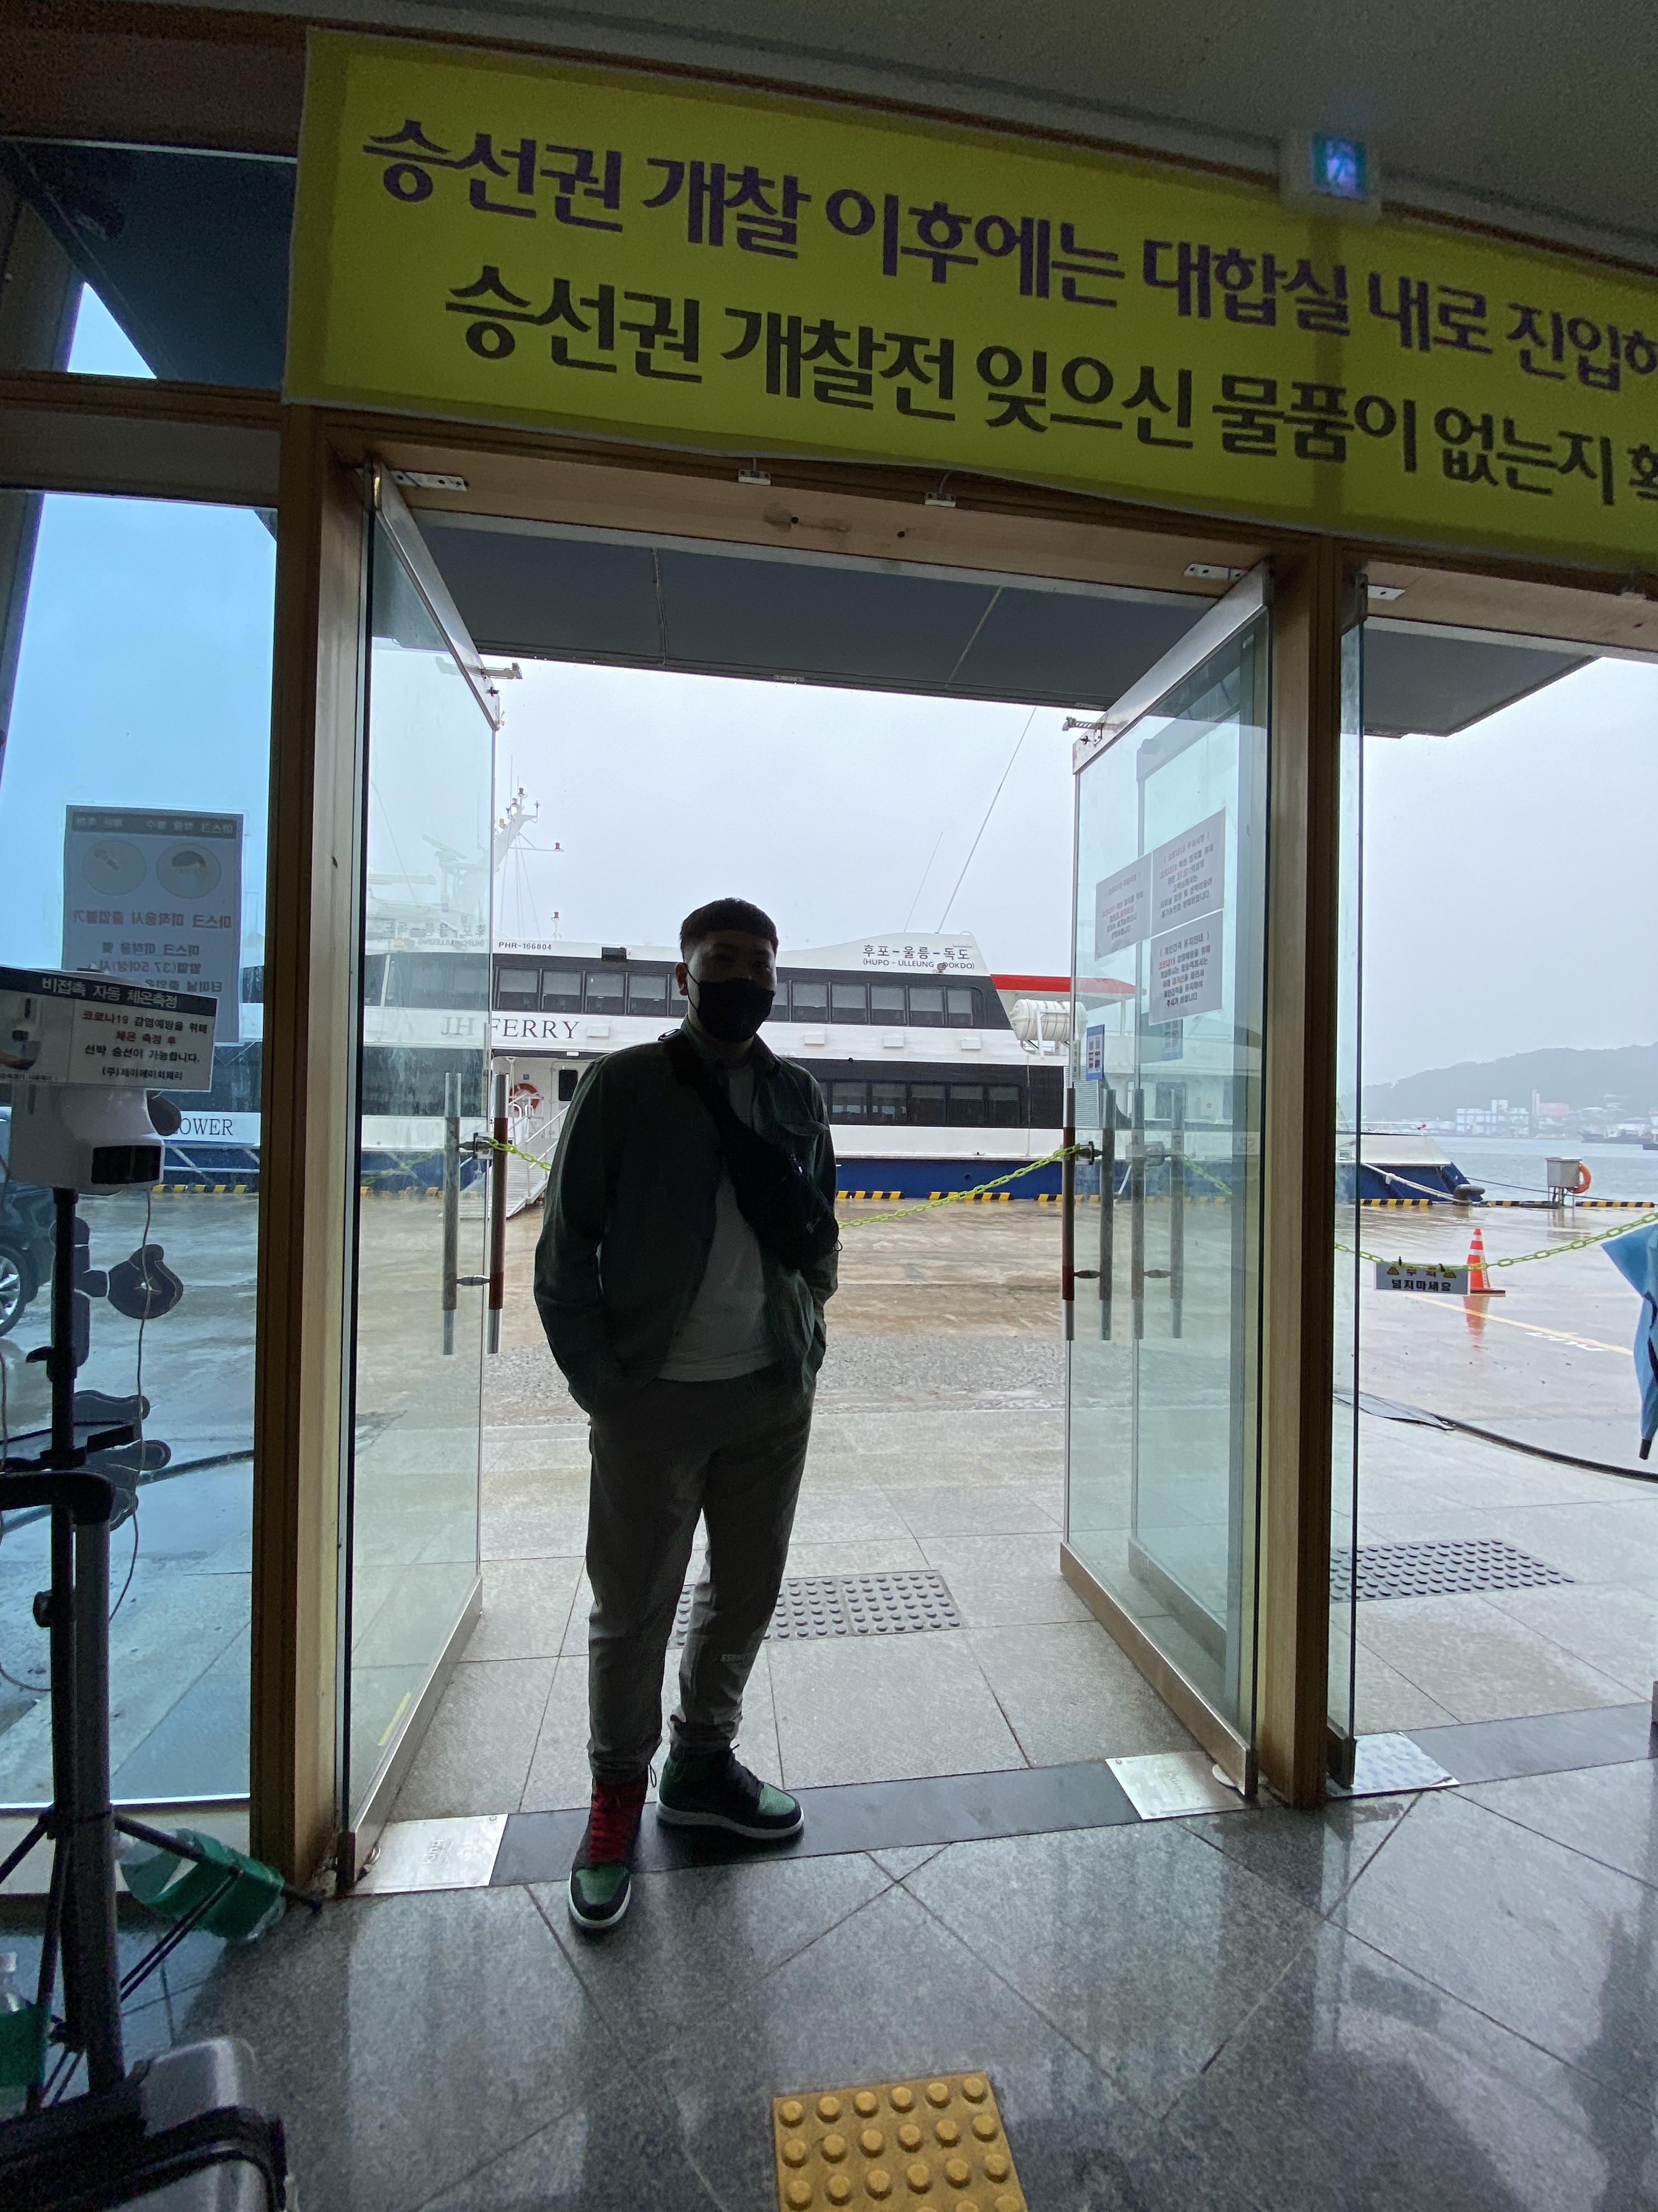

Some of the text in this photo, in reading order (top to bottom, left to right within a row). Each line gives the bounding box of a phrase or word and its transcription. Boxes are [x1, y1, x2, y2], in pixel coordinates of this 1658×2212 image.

[363, 119, 623, 233] 승선권
[642, 157, 812, 260] 개찰
[825, 188, 1126, 308] 이후에는
[1142, 239, 1351, 336] 대합실
[1368, 271, 1494, 355] 내로
[445, 264, 703, 383] 승선권
[721, 307, 956, 422] 개찰전
[976, 345, 1194, 449] 잊으신
[1212, 373, 1418, 472] 물품이
[1435, 407, 1616, 505] 없는지
[498, 941, 552, 950] PHR-166804
[863, 958, 889, 966] (HUPO
[92, 984, 121, 1001] 자동
[441, 1017, 580, 1039] JH FERRY
[174, 1118, 234, 1136] OWER
